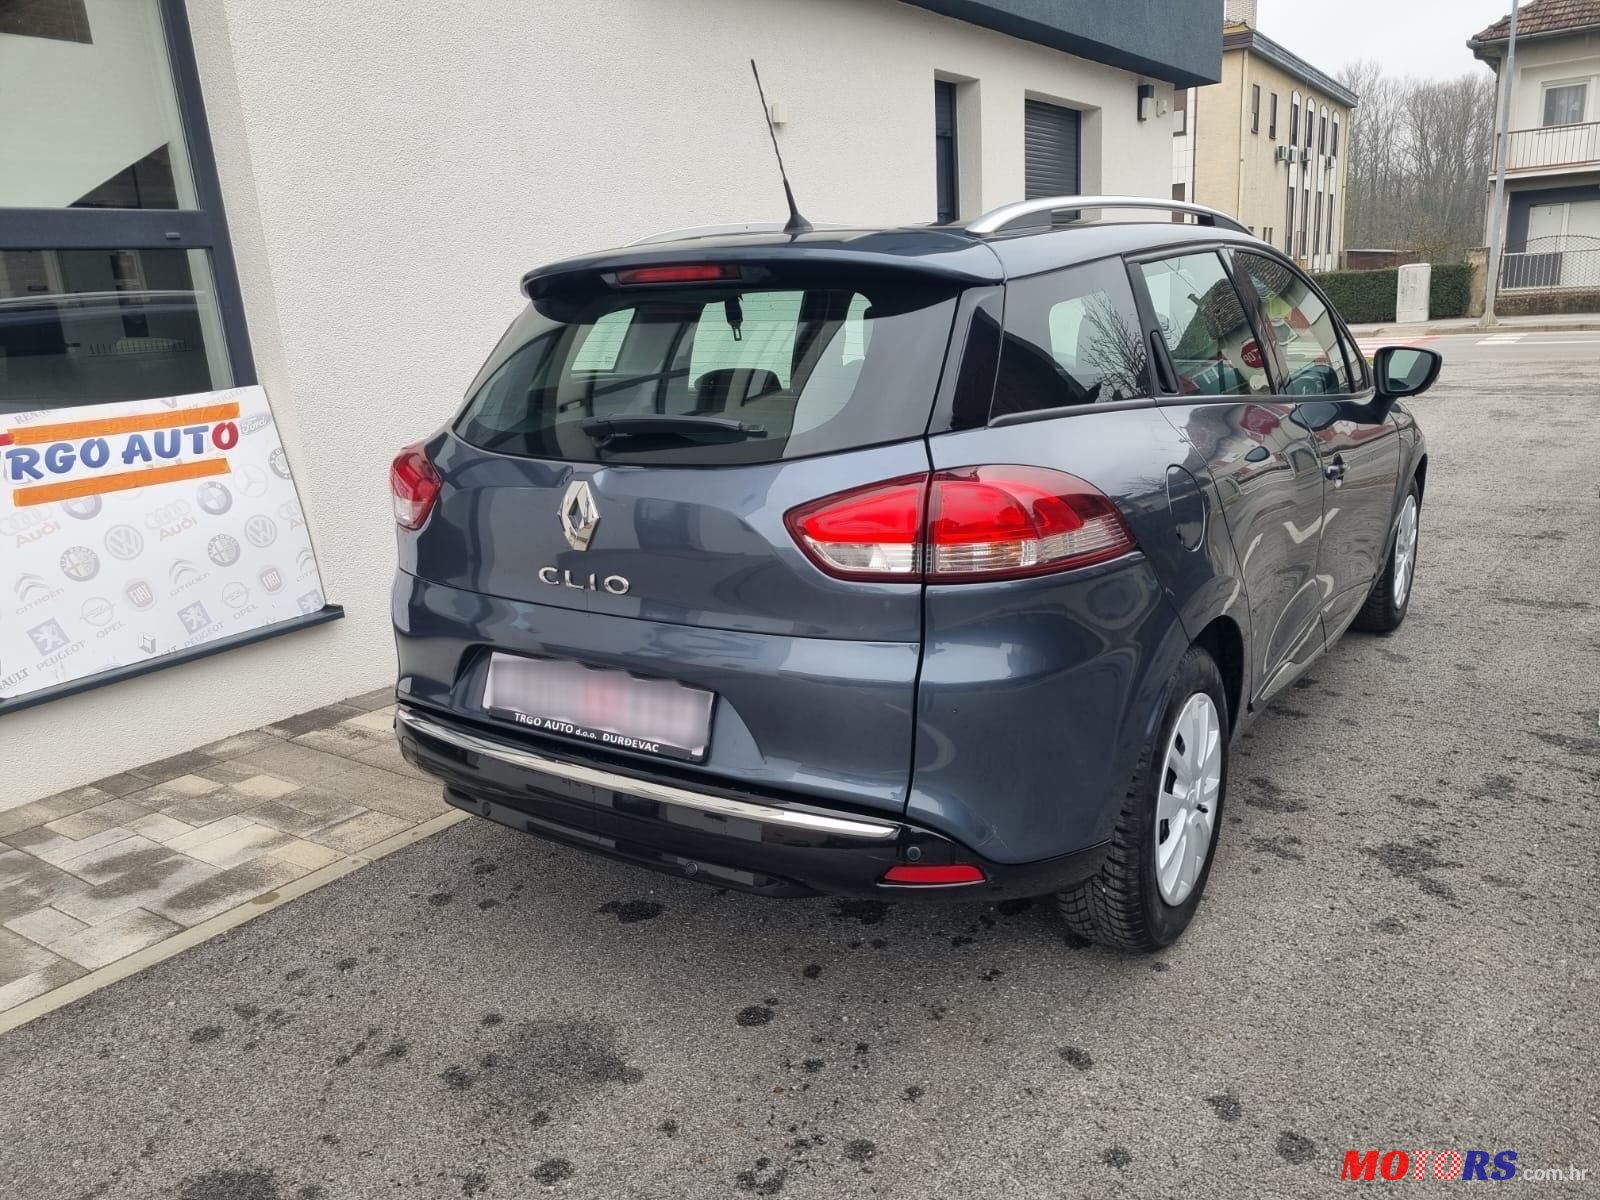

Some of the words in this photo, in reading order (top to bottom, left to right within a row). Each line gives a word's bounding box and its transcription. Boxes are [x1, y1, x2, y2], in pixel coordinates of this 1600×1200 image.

[121, 421, 240, 465] AUTO
[538, 566, 630, 595] CLIO
[35, 639, 87, 672] PEUGEOT
[514, 711, 542, 727] TRGO
[543, 719, 574, 734] AUTO
